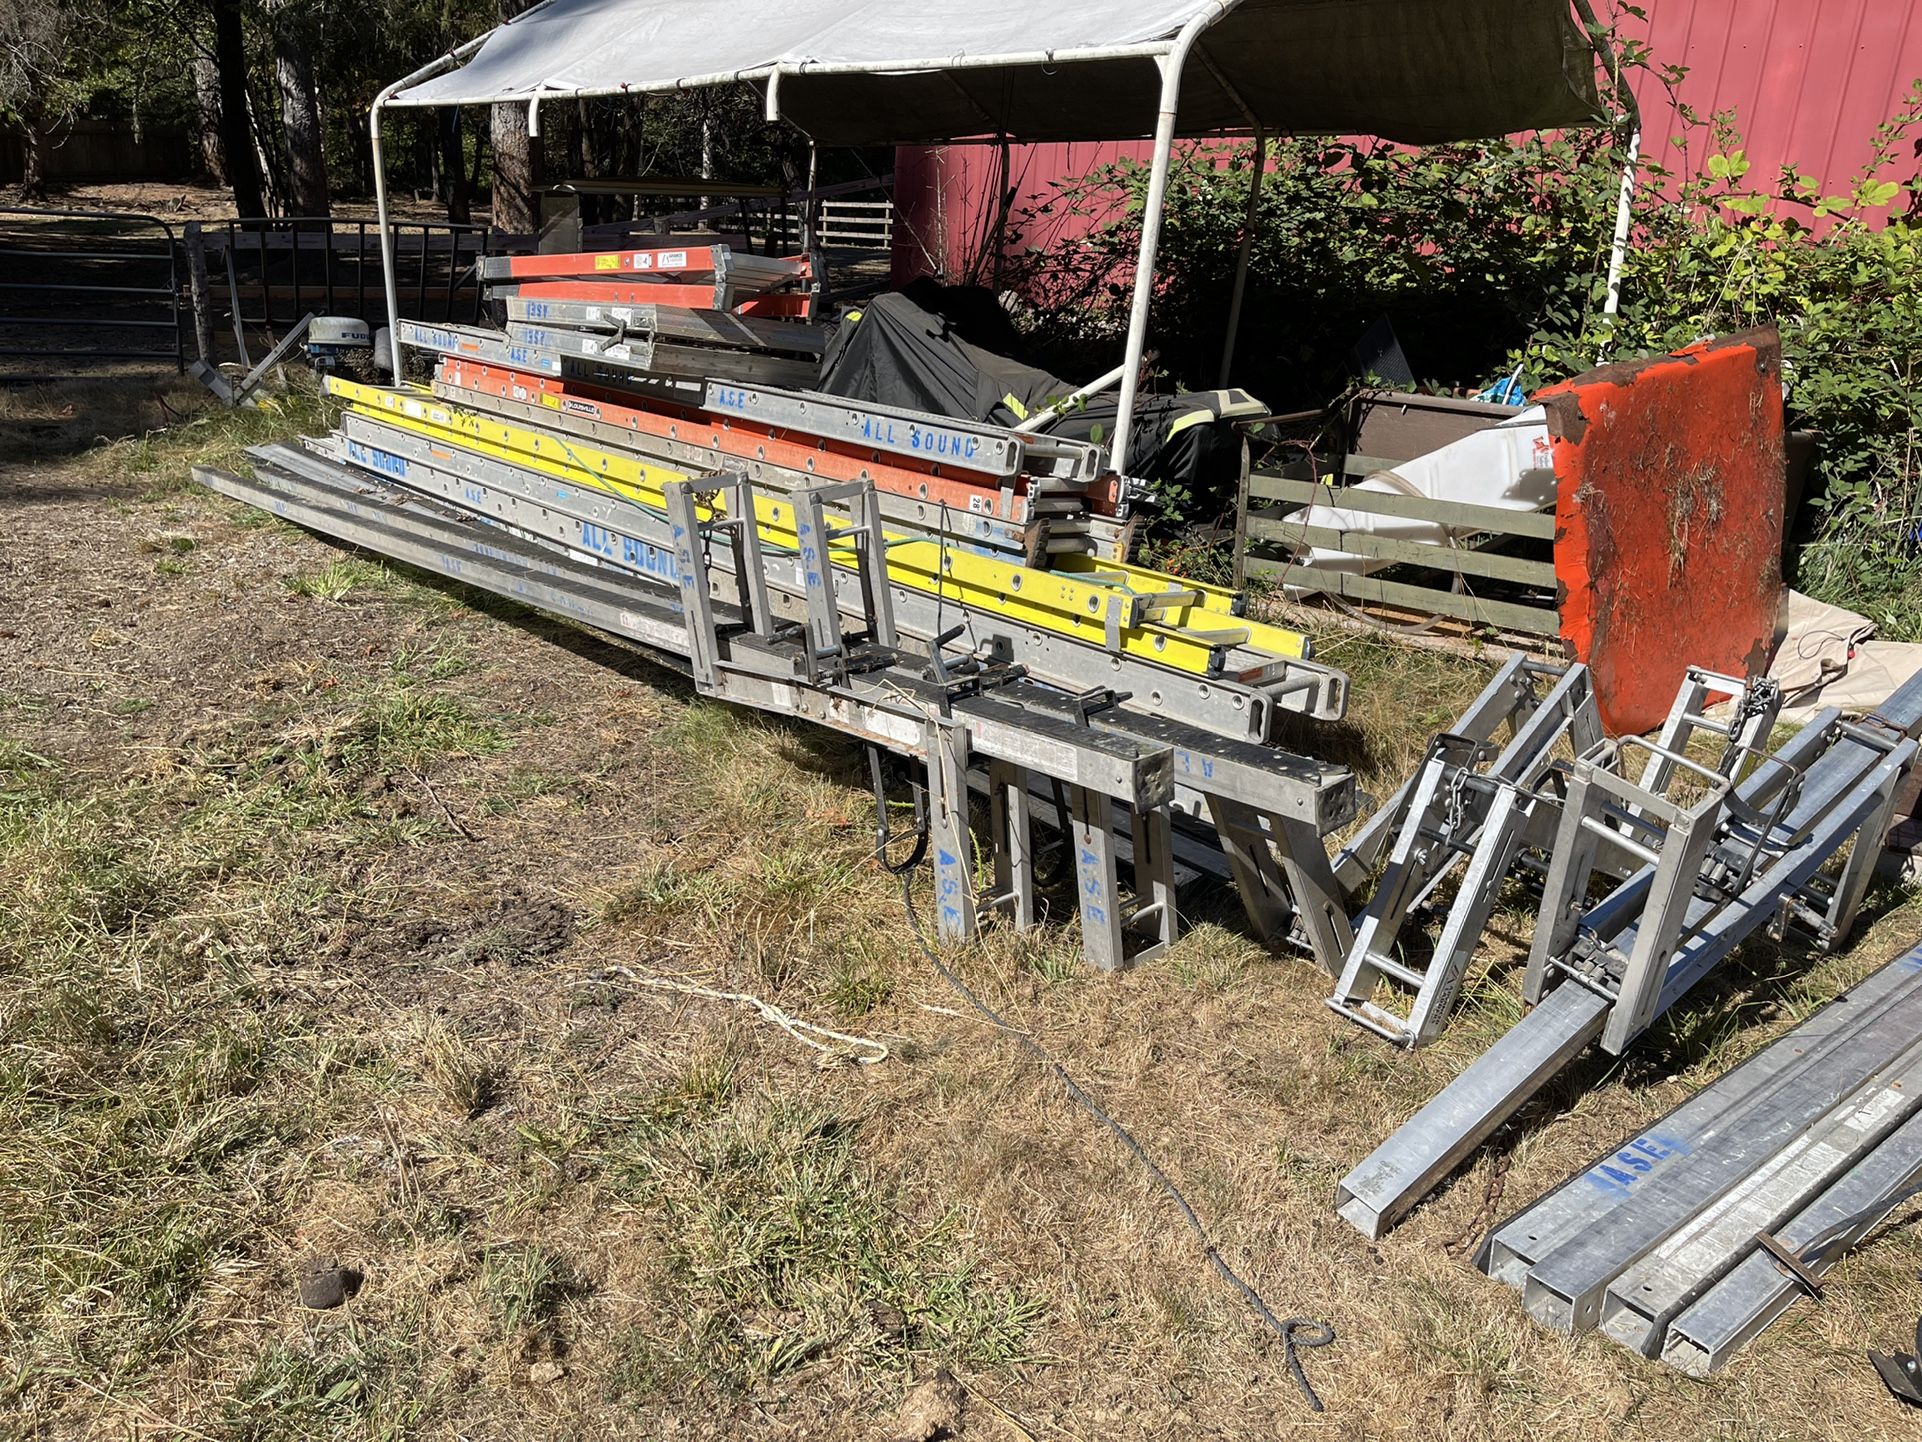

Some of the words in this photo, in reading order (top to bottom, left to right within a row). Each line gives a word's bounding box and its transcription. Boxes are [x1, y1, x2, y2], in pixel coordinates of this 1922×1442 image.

[863, 419, 895, 444] ALL
[911, 430, 975, 458] SOUND
[1599, 1138, 1671, 1186] ASE
